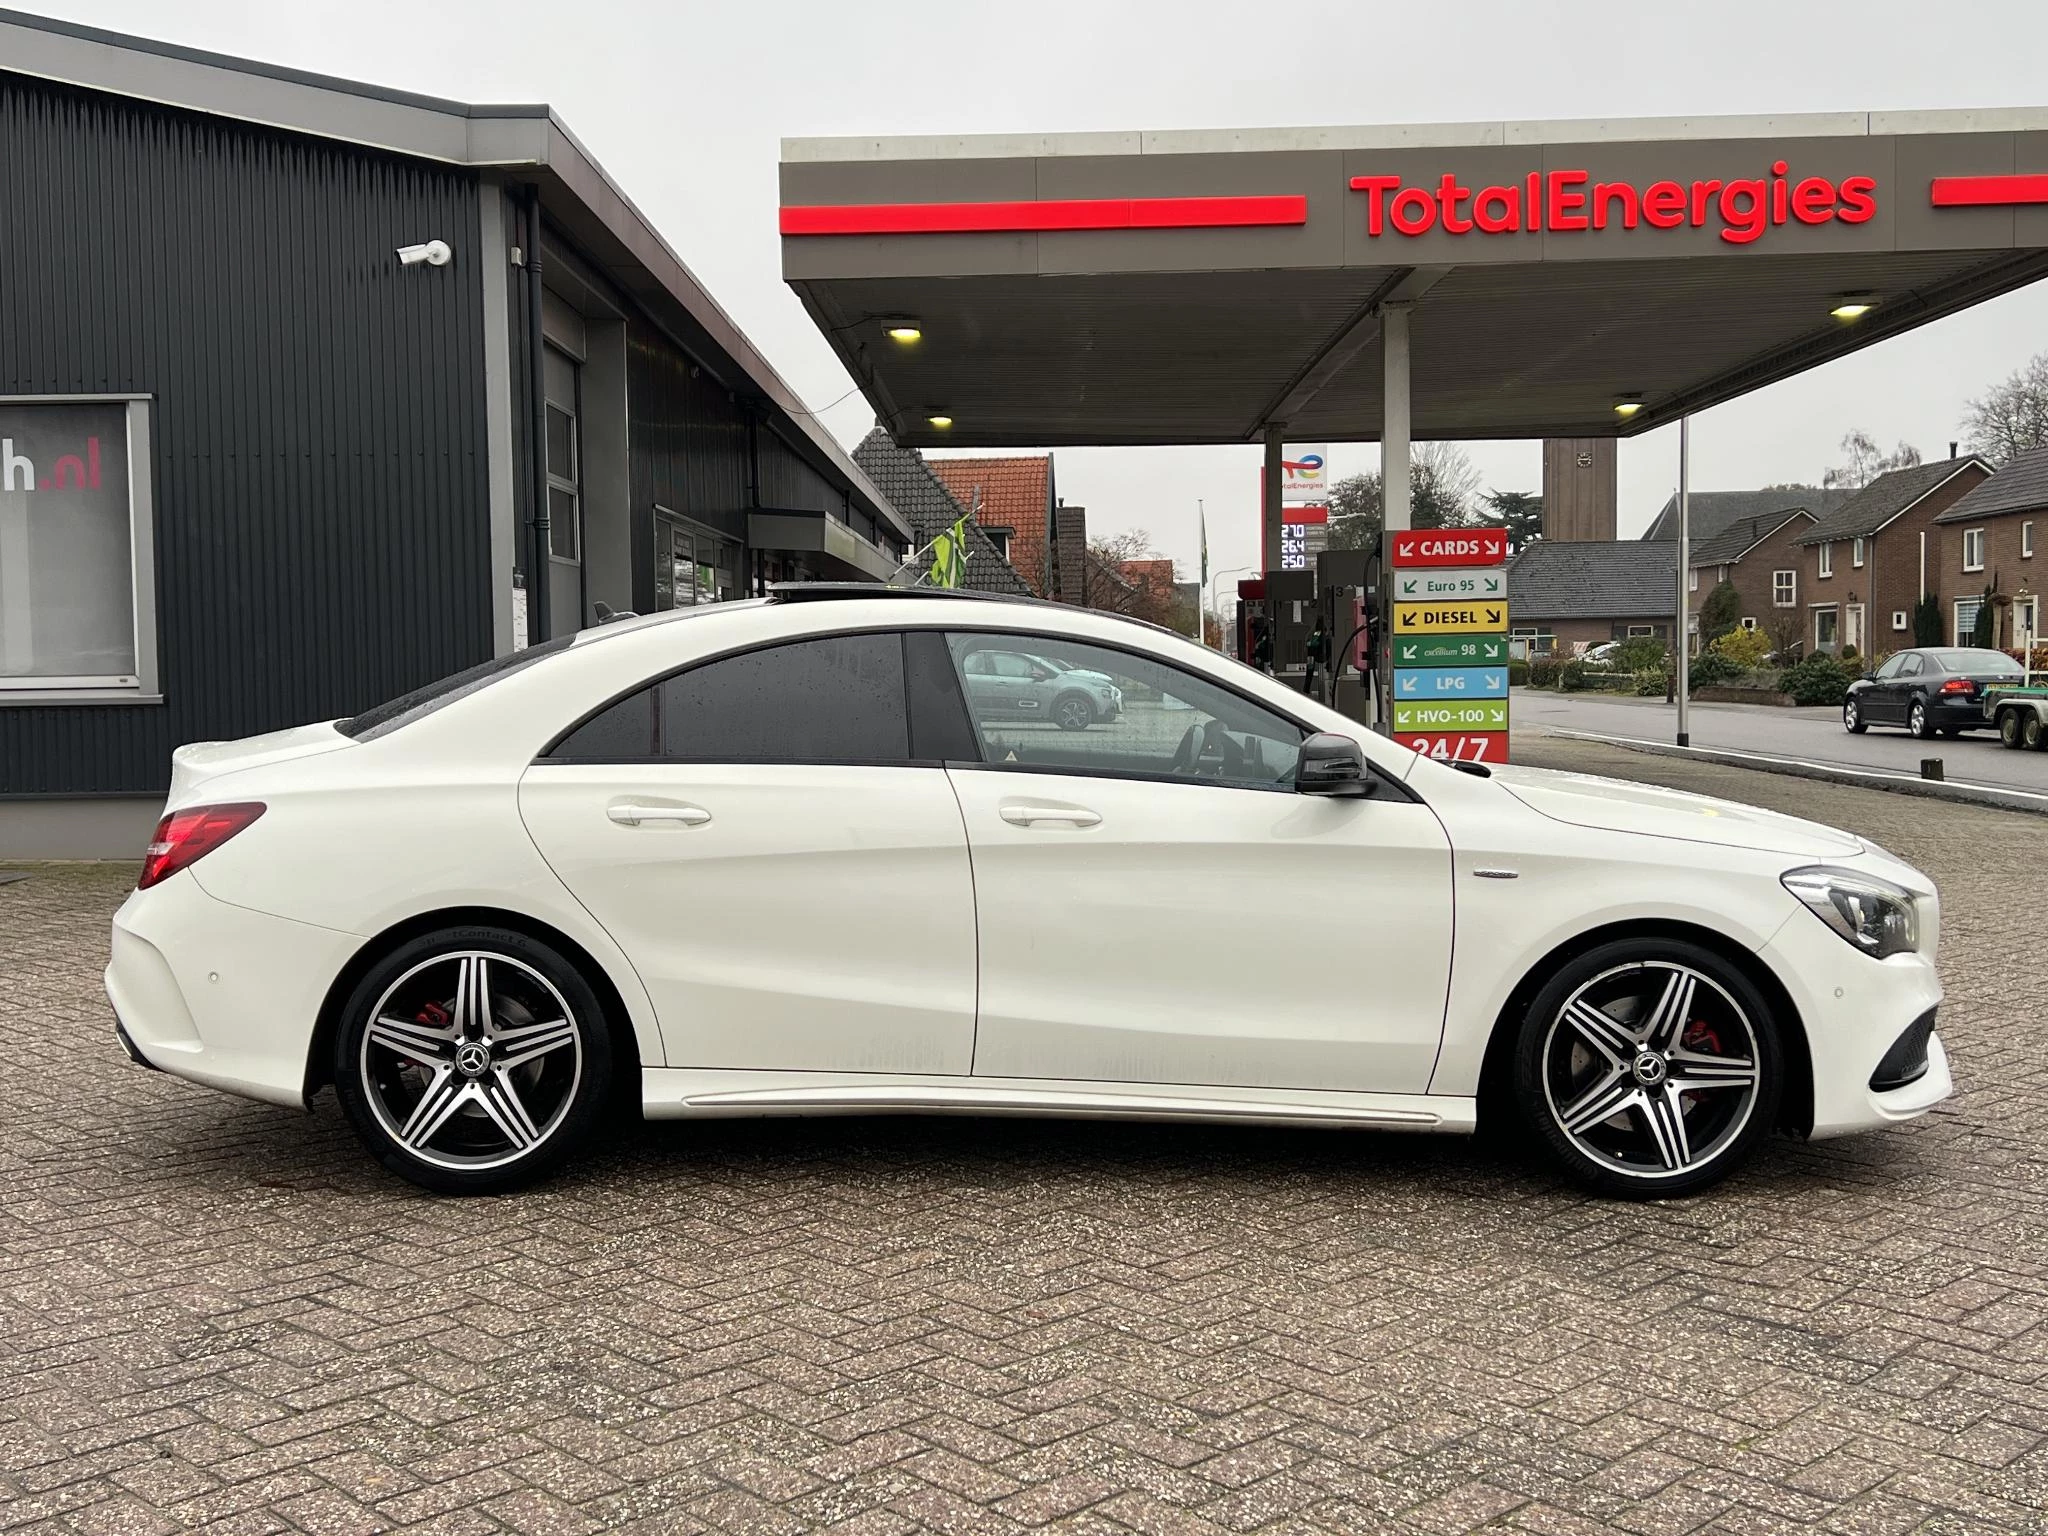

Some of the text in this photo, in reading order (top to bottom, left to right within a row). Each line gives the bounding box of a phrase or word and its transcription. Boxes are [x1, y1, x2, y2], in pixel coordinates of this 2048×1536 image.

[1349, 160, 1877, 243] TotalEnergies
[2, 436, 101, 491] h.nl
[1420, 540, 1480, 556] CARDS
[1427, 579, 1475, 592] Euro 95
[1424, 611, 1477, 625] DIESEL
[1461, 644, 1477, 656] 98
[1436, 676, 1465, 690] LPG
[1417, 709, 1484, 723] HVO-100
[1412, 737, 1489, 762] 24/7
